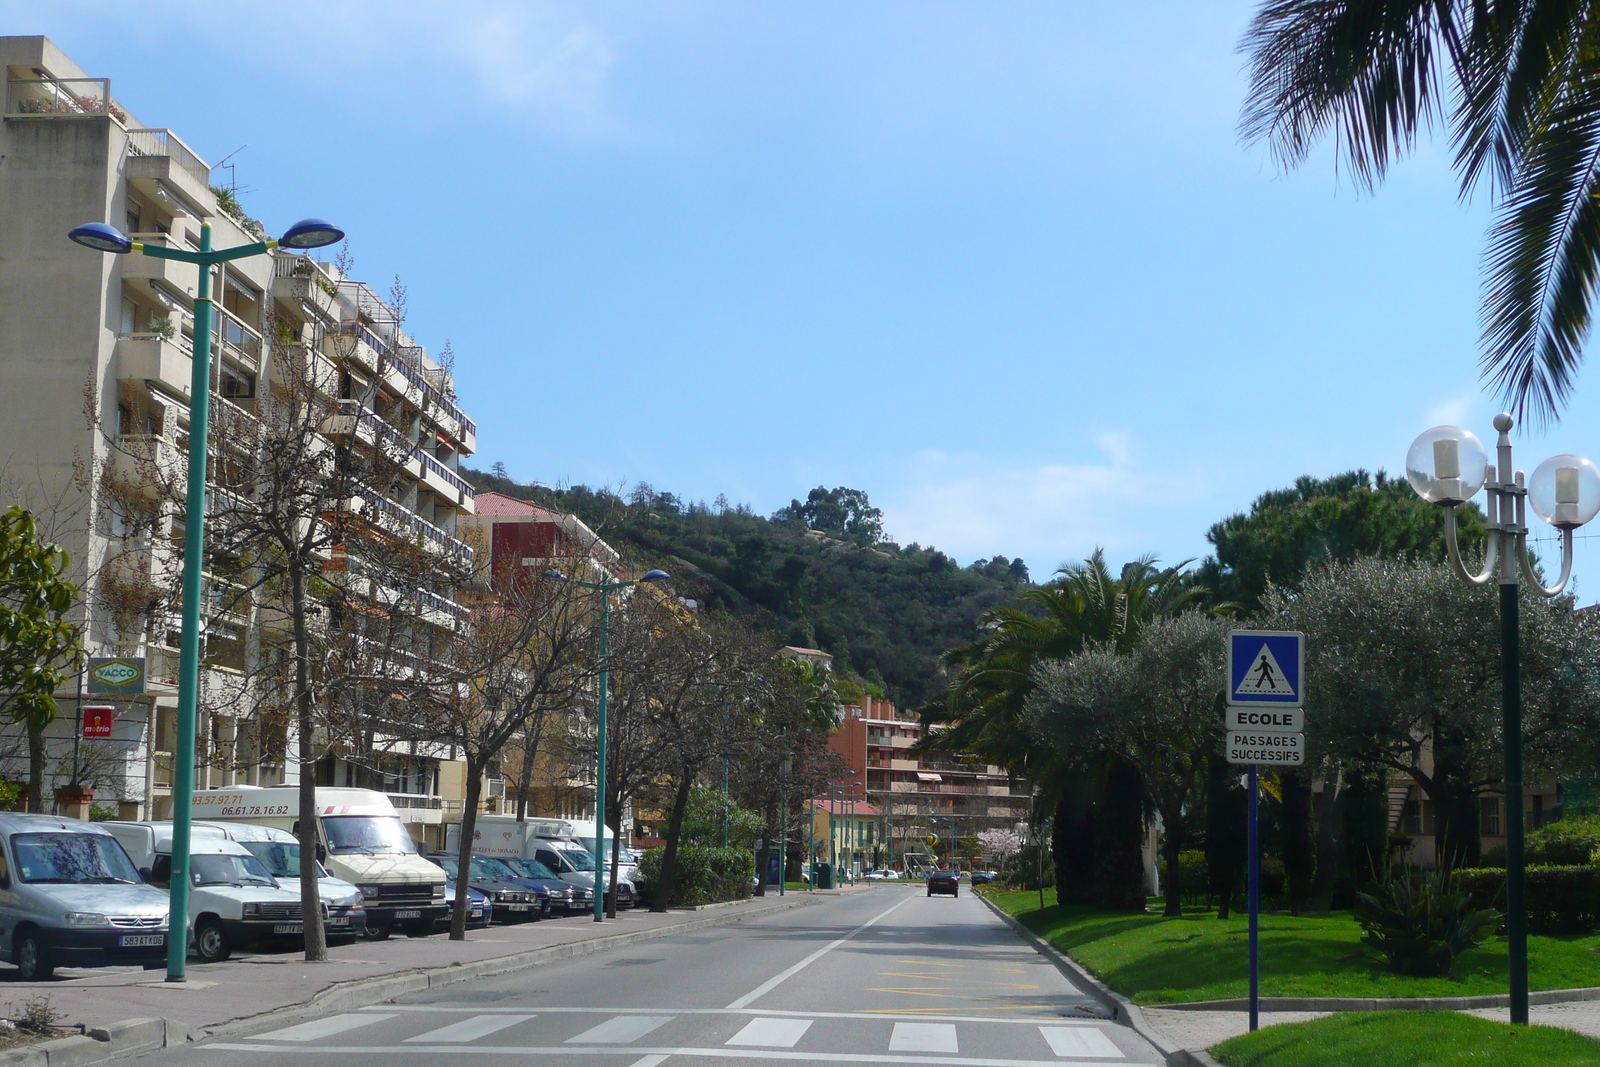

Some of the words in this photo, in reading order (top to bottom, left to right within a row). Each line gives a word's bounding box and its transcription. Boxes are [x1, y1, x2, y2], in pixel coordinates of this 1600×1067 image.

[98, 668, 135, 678] YACCO
[1237, 712, 1293, 726] ECOLE
[84, 725, 110, 733] motrio
[1234, 735, 1297, 747] PASSAGES
[1231, 748, 1300, 762] SUCCÉSSIFS
[221, 805, 289, 816] 06.61.78.16.82
